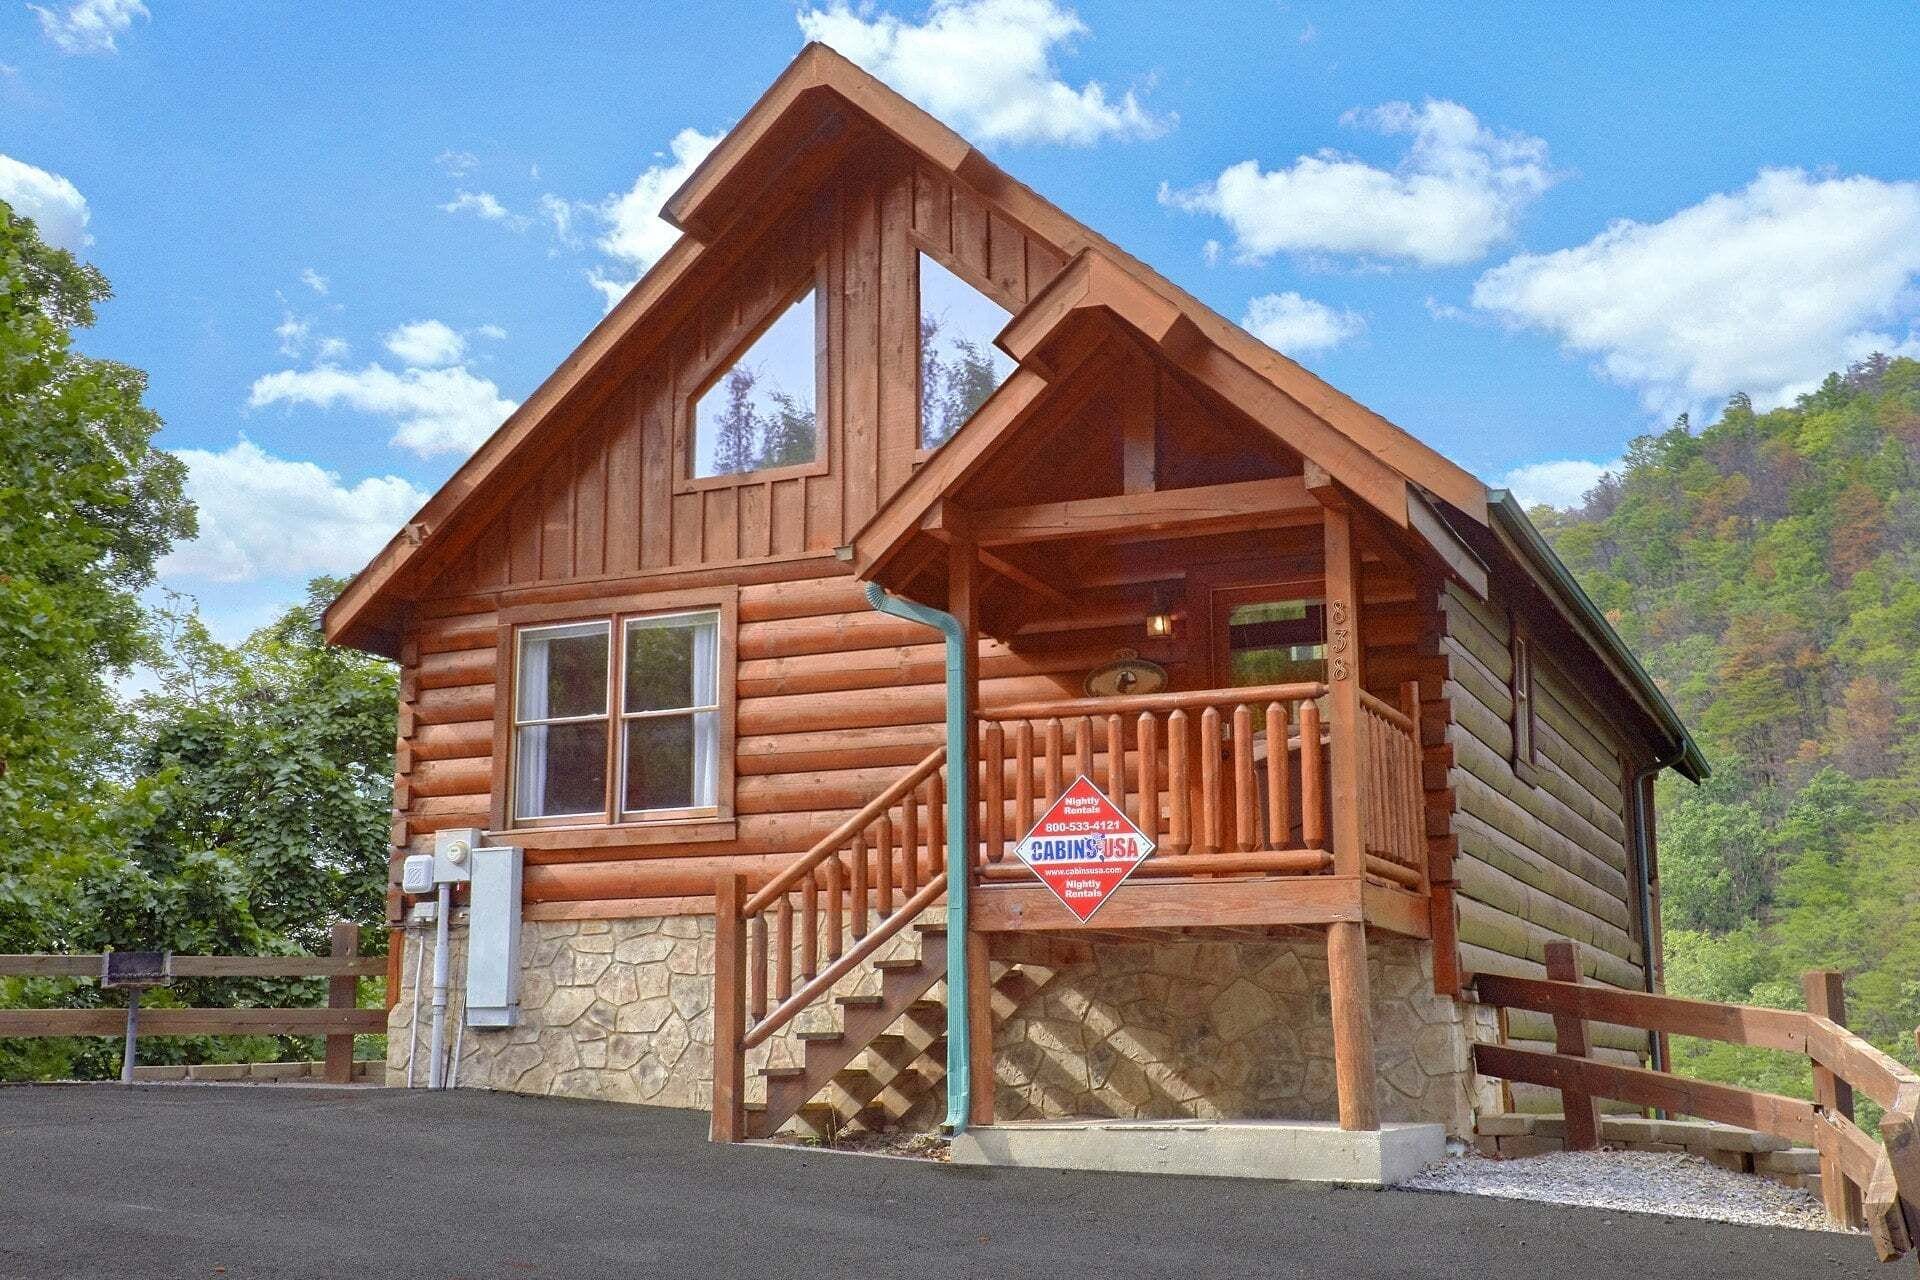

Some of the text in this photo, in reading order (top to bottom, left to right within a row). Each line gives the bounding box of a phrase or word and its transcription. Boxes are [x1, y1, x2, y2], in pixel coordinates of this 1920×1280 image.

[1065, 797, 1099, 806] Nightly
[1064, 806, 1100, 814] Rentals
[1045, 820, 1120, 832] 800-533-4121
[1031, 837, 1138, 861] CABINS USA
[1045, 867, 1122, 876] www.cabinsusa.com
[1066, 880, 1101, 889] Nightly
[1065, 889, 1102, 897] Rentals
